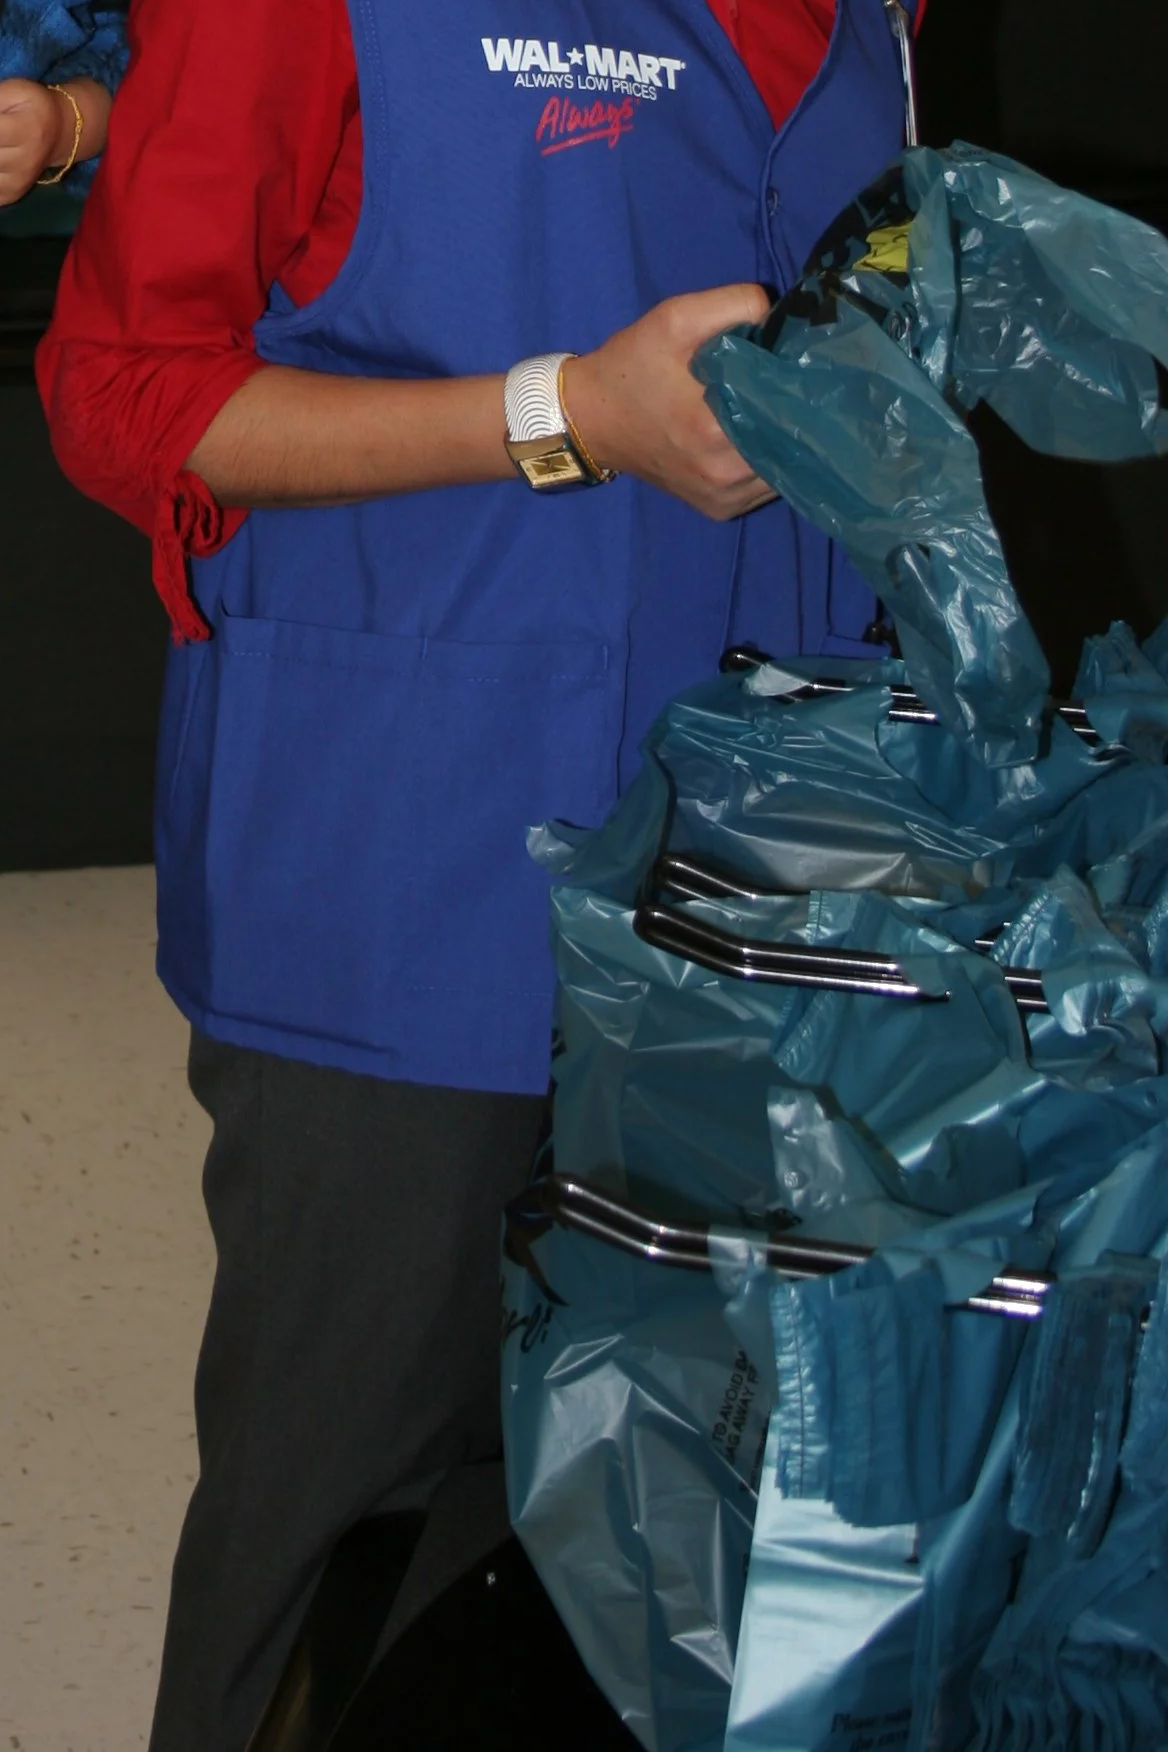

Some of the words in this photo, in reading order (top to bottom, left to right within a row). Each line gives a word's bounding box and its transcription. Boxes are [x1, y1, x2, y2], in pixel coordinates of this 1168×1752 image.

[514, 73, 575, 90] ALWAYS
[577, 74, 610, 93] LOW
[612, 80, 658, 101] PRICES
[535, 95, 641, 150] Always
[718, 1372, 744, 1423] AVOID
[731, 1385, 756, 1432] AWAY
